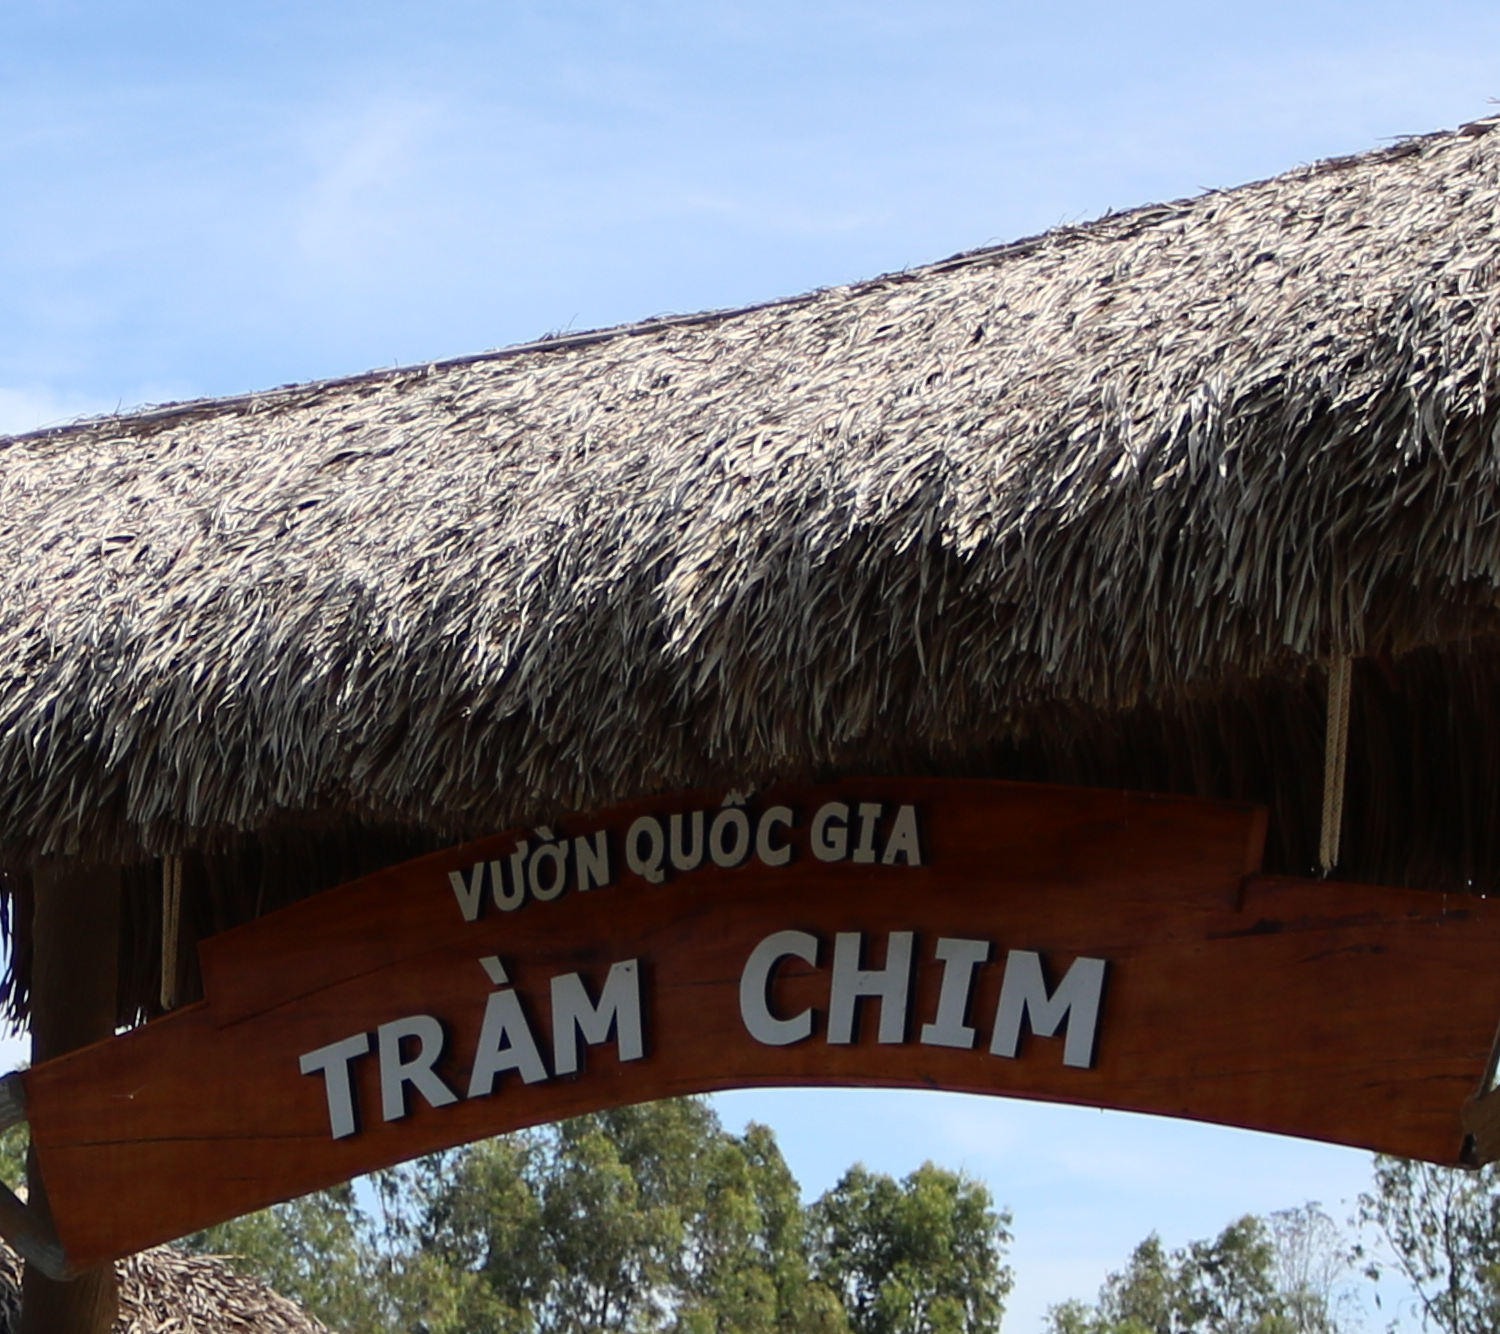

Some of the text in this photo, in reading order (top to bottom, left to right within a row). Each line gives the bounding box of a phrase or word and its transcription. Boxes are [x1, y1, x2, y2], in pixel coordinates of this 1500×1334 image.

[447, 789, 920, 922] VƯỜN QUỐC GIA
[299, 929, 1106, 1140] TRÀM CHIM
